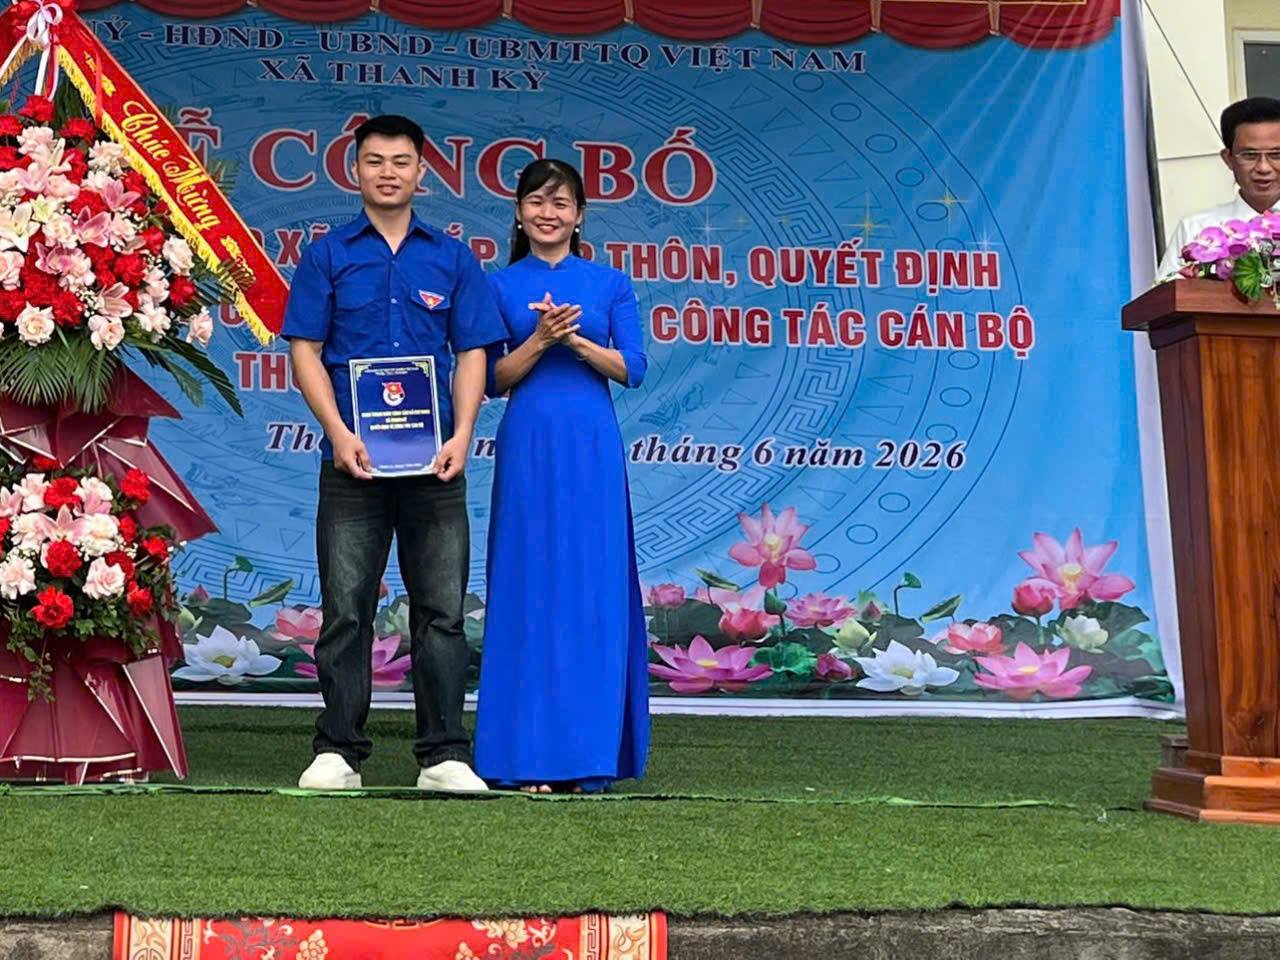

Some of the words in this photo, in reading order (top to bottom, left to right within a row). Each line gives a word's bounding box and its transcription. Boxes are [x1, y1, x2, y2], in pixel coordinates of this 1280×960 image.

[164, 24, 284, 49] HĐND
[320, 31, 433, 55] UBND
[467, 37, 650, 69] UBMTTQ
[661, 43, 759, 73] VIỆT
[770, 48, 866, 74] NAM
[259, 55, 317, 82] XÃ
[328, 61, 481, 89] THANH
[490, 64, 549, 93] KỲ
[121, 100, 171, 160] Chúc
[162, 154, 221, 232] Mừng
[574, 128, 717, 207] BỐ
[748, 239, 883, 288] QUYẾT
[895, 248, 1000, 295] ĐỊNH
[651, 298, 770, 344] CÔNG
[782, 303, 867, 348] TÁC
[877, 304, 966, 349] CÁN
[978, 306, 1035, 358] BỘ
[630, 435, 740, 471] tháng
[753, 437, 774, 466] 6
[784, 440, 864, 468] năm
[873, 440, 966, 470] 2026
